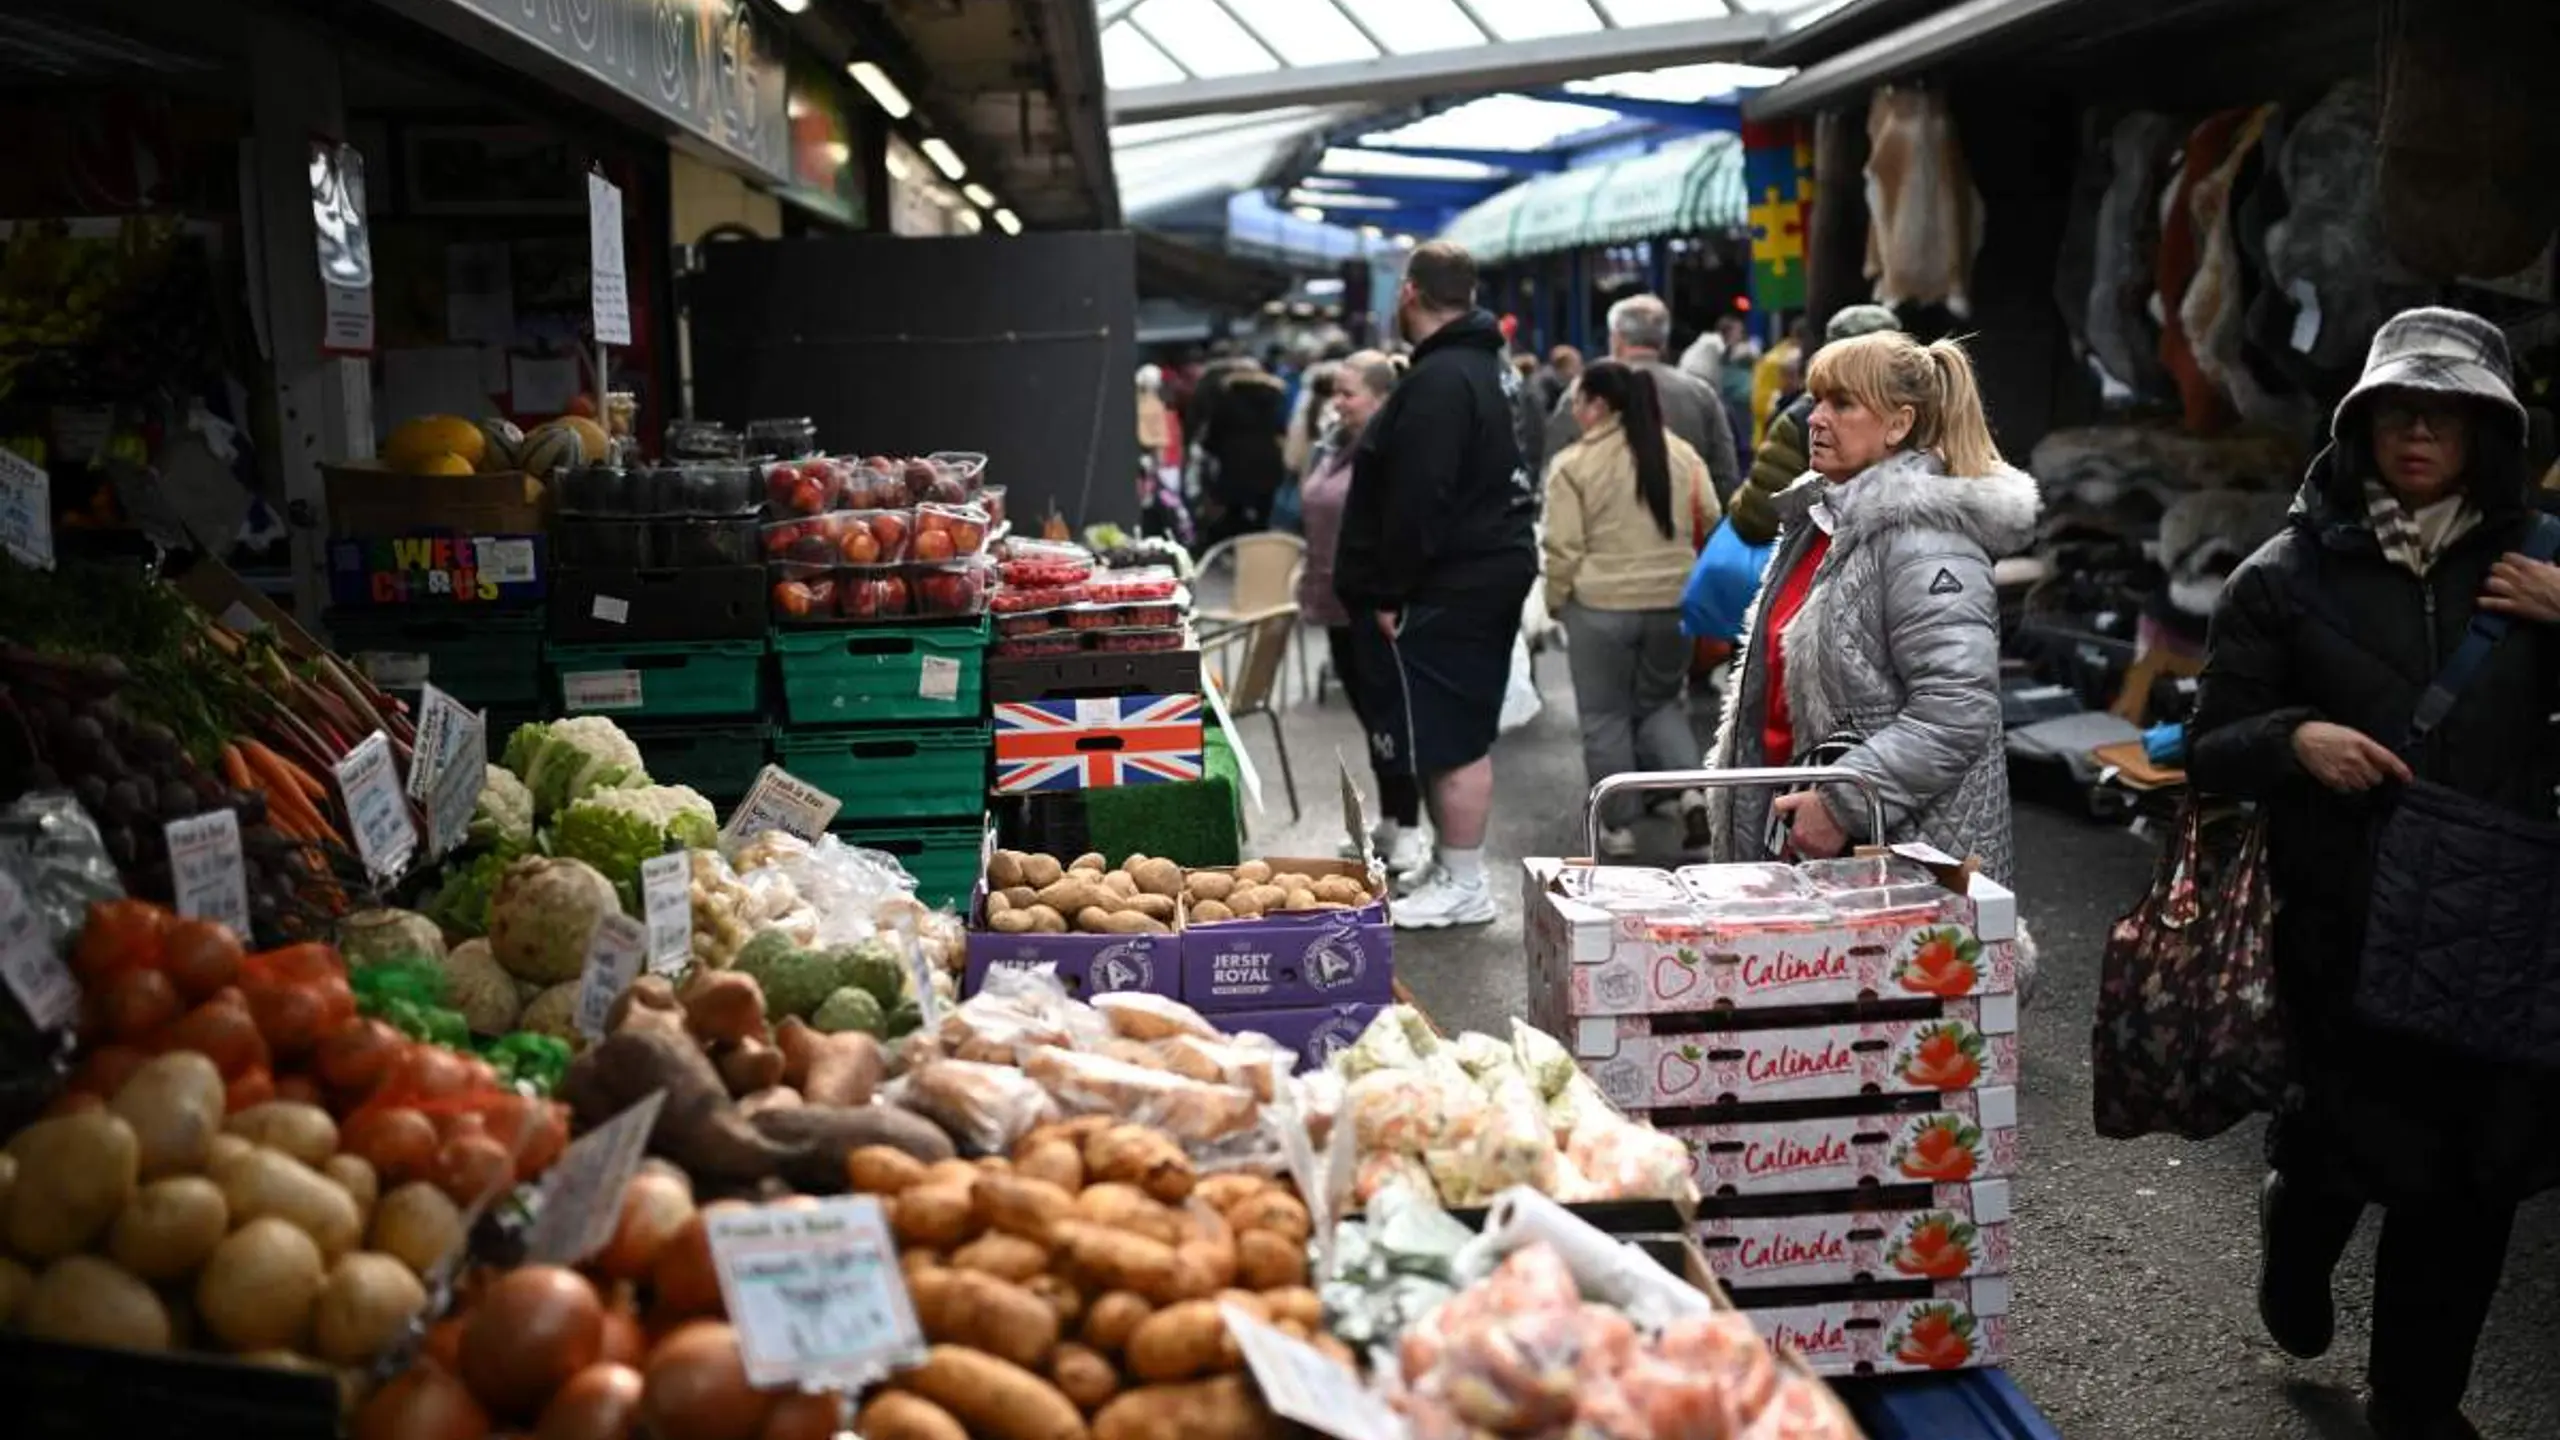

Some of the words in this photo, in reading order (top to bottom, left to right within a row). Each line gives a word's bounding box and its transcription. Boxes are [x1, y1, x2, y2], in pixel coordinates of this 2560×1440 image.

[1211, 953, 1274, 970] JERSEY
[1212, 968, 1273, 984] ROYAL
[1742, 946, 1847, 987] Calinda
[1746, 1040, 1850, 1082] Calinda
[1744, 1133, 1848, 1174] Calinda
[1740, 1229, 1845, 1269] Calinda
